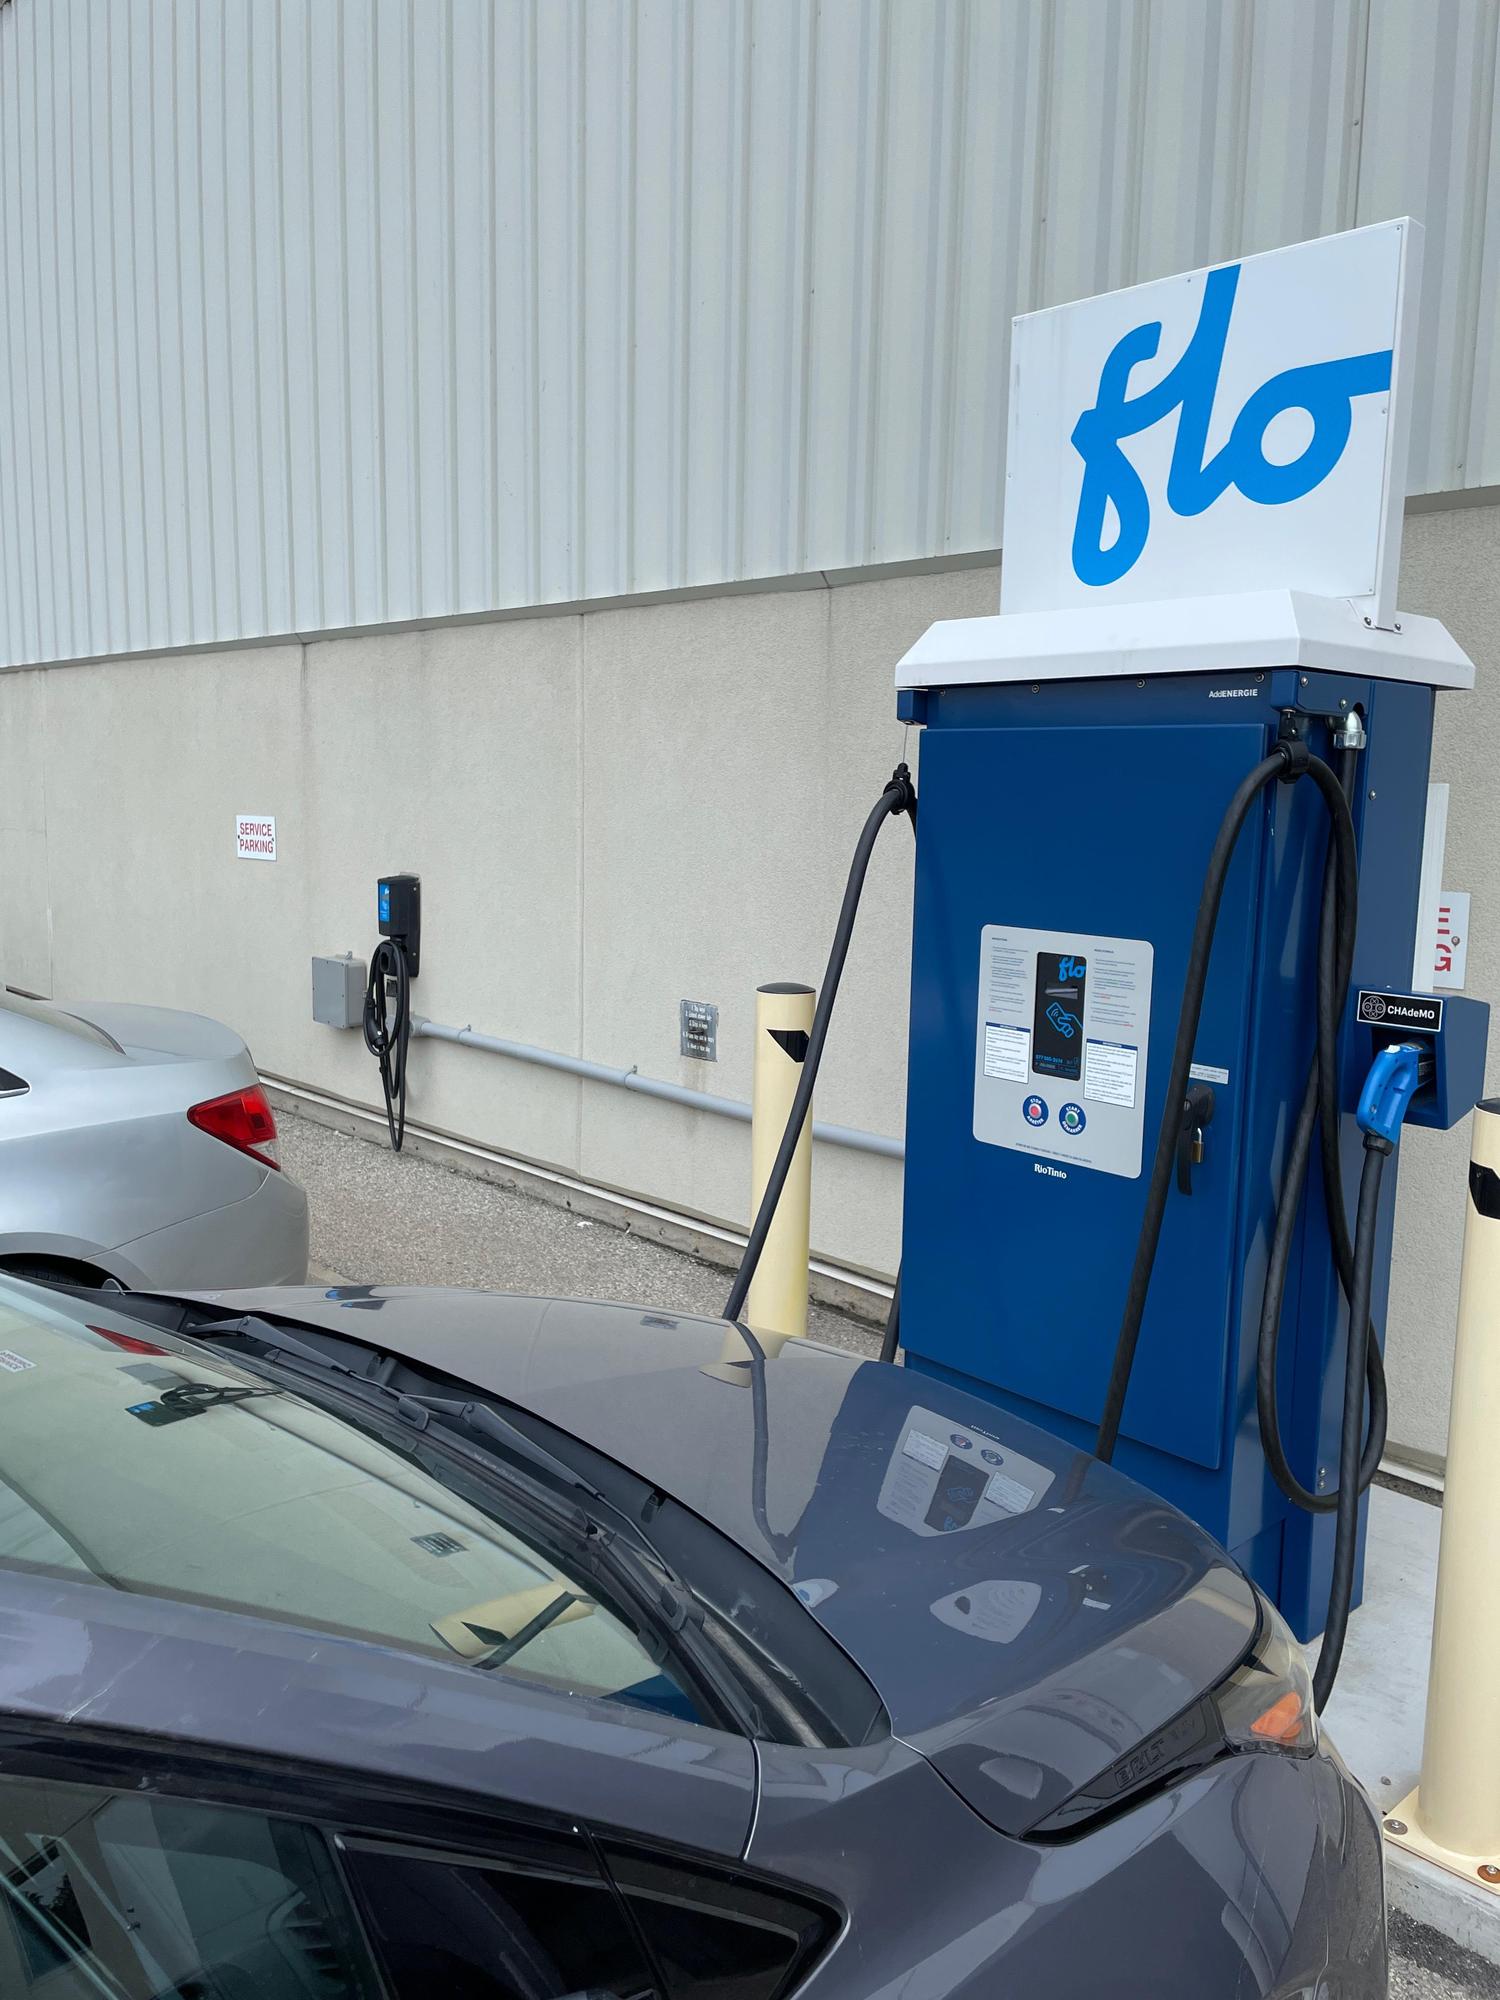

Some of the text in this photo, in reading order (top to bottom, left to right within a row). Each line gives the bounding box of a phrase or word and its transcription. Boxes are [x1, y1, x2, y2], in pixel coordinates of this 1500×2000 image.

[1071, 264, 1394, 587] flo
[1208, 688, 1258, 698] AddENERGIE
[239, 822, 272, 836] SERVICE
[239, 838, 273, 853] PARKING
[1059, 955, 1086, 982] flo
[1387, 1005, 1435, 1019] CHAdeMO
